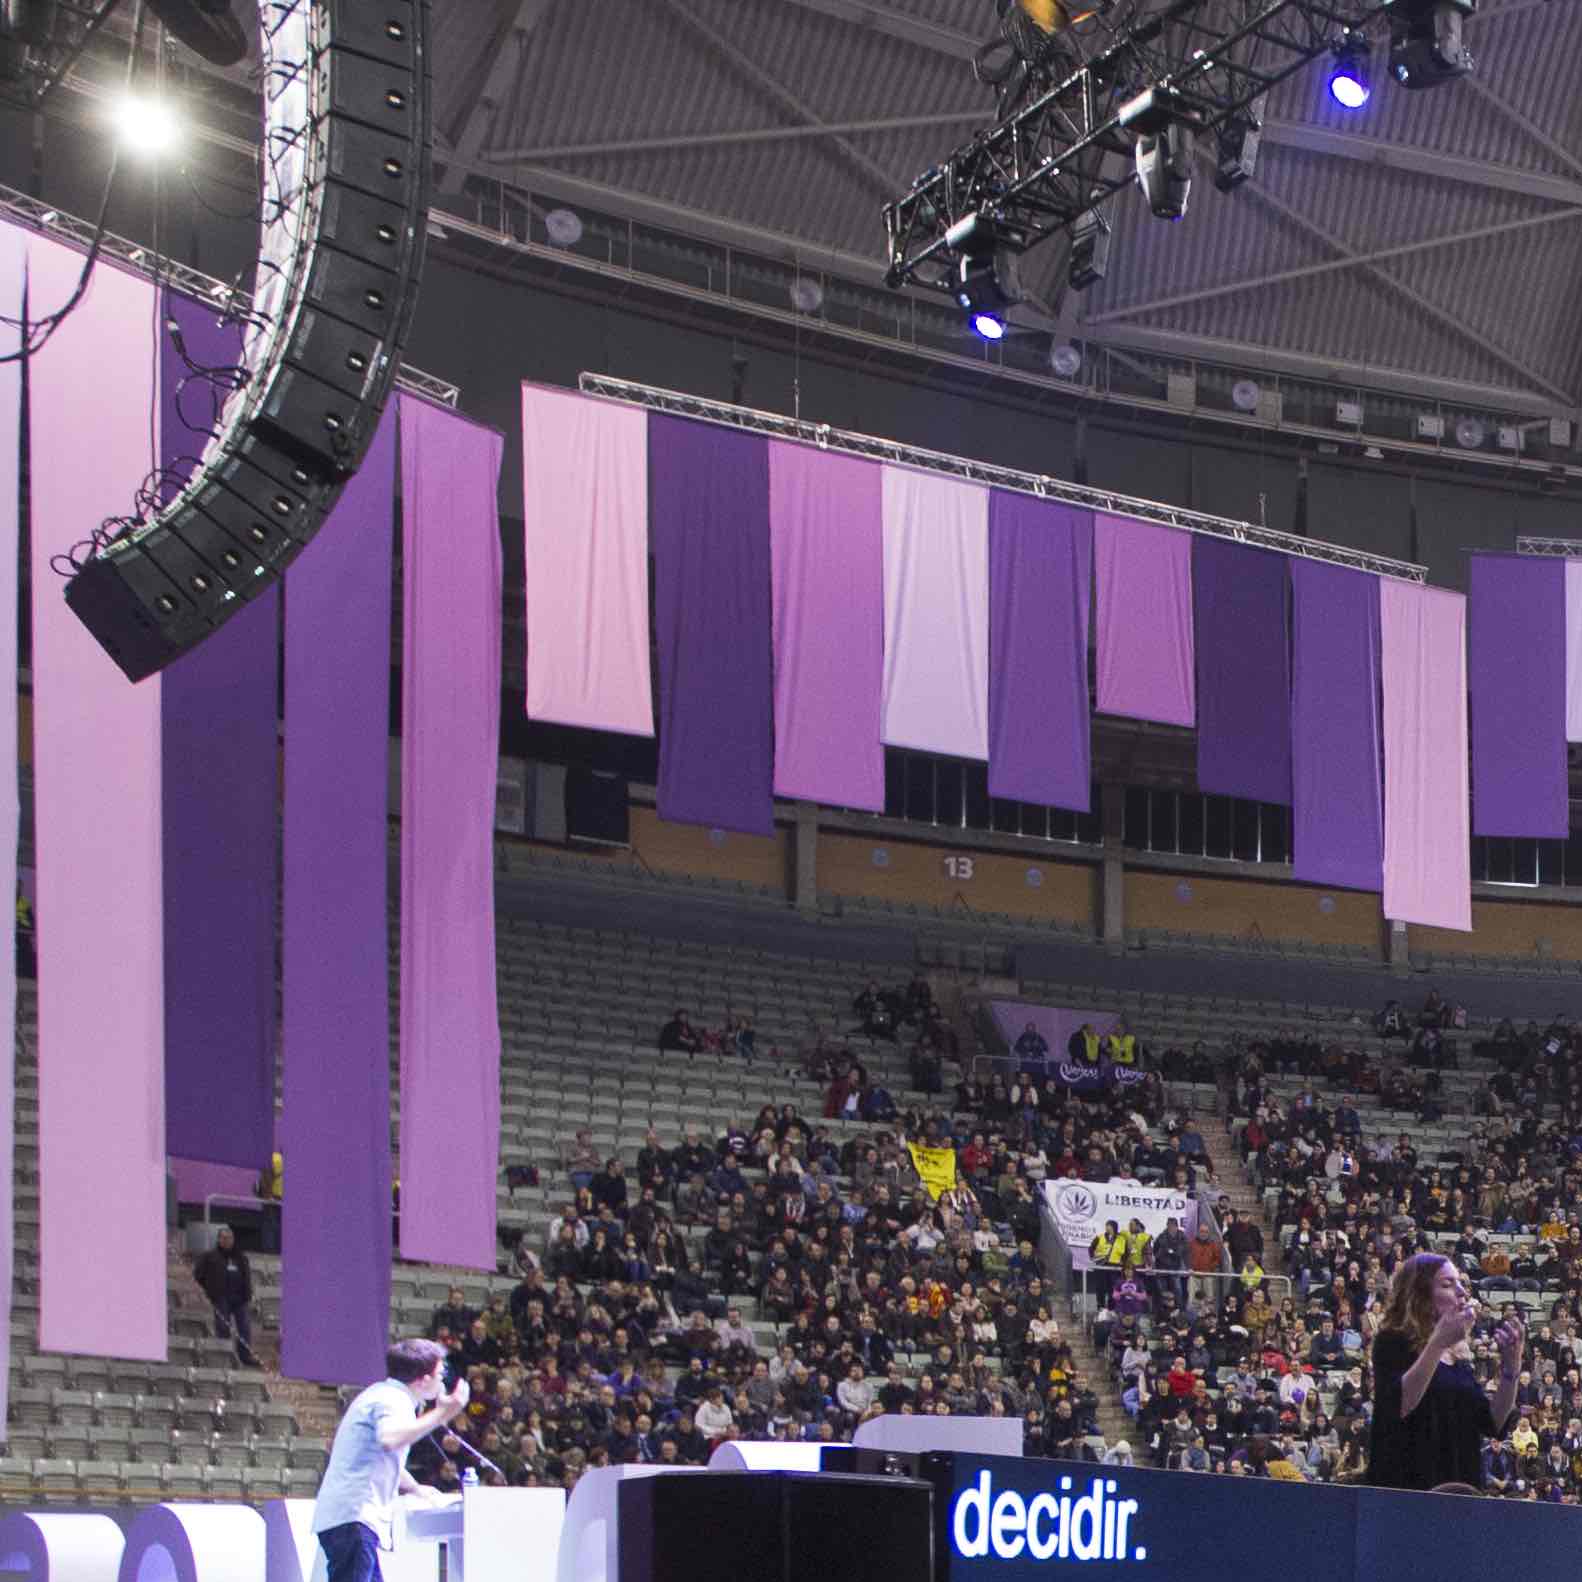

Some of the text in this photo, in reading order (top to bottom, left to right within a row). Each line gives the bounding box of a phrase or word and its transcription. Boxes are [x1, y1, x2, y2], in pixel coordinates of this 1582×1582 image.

[943, 856, 974, 880] 13
[1104, 1192, 1187, 1211] LIBERTAD
[953, 1469, 1147, 1560] decidir.
